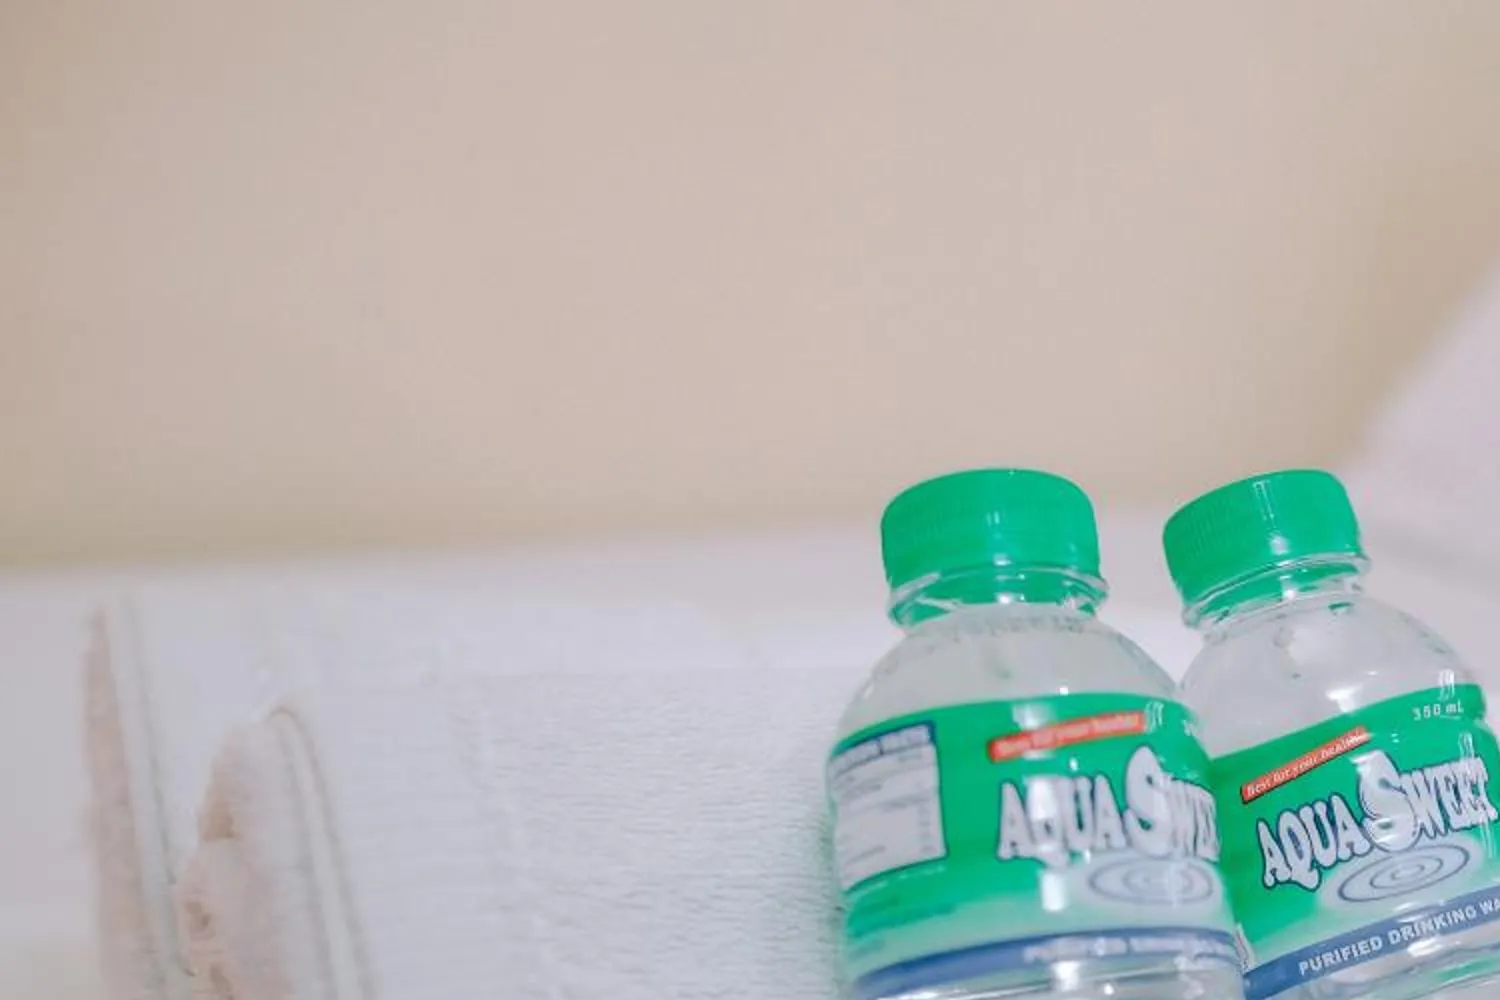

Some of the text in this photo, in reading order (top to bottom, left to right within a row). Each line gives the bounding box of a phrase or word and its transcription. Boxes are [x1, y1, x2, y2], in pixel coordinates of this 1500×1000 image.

[996, 773, 1128, 870] AQUA
[1256, 749, 1499, 892] AQUA SWEET
[1299, 938, 1384, 976] PURIFIED
[1388, 907, 1478, 945] DRINKING
